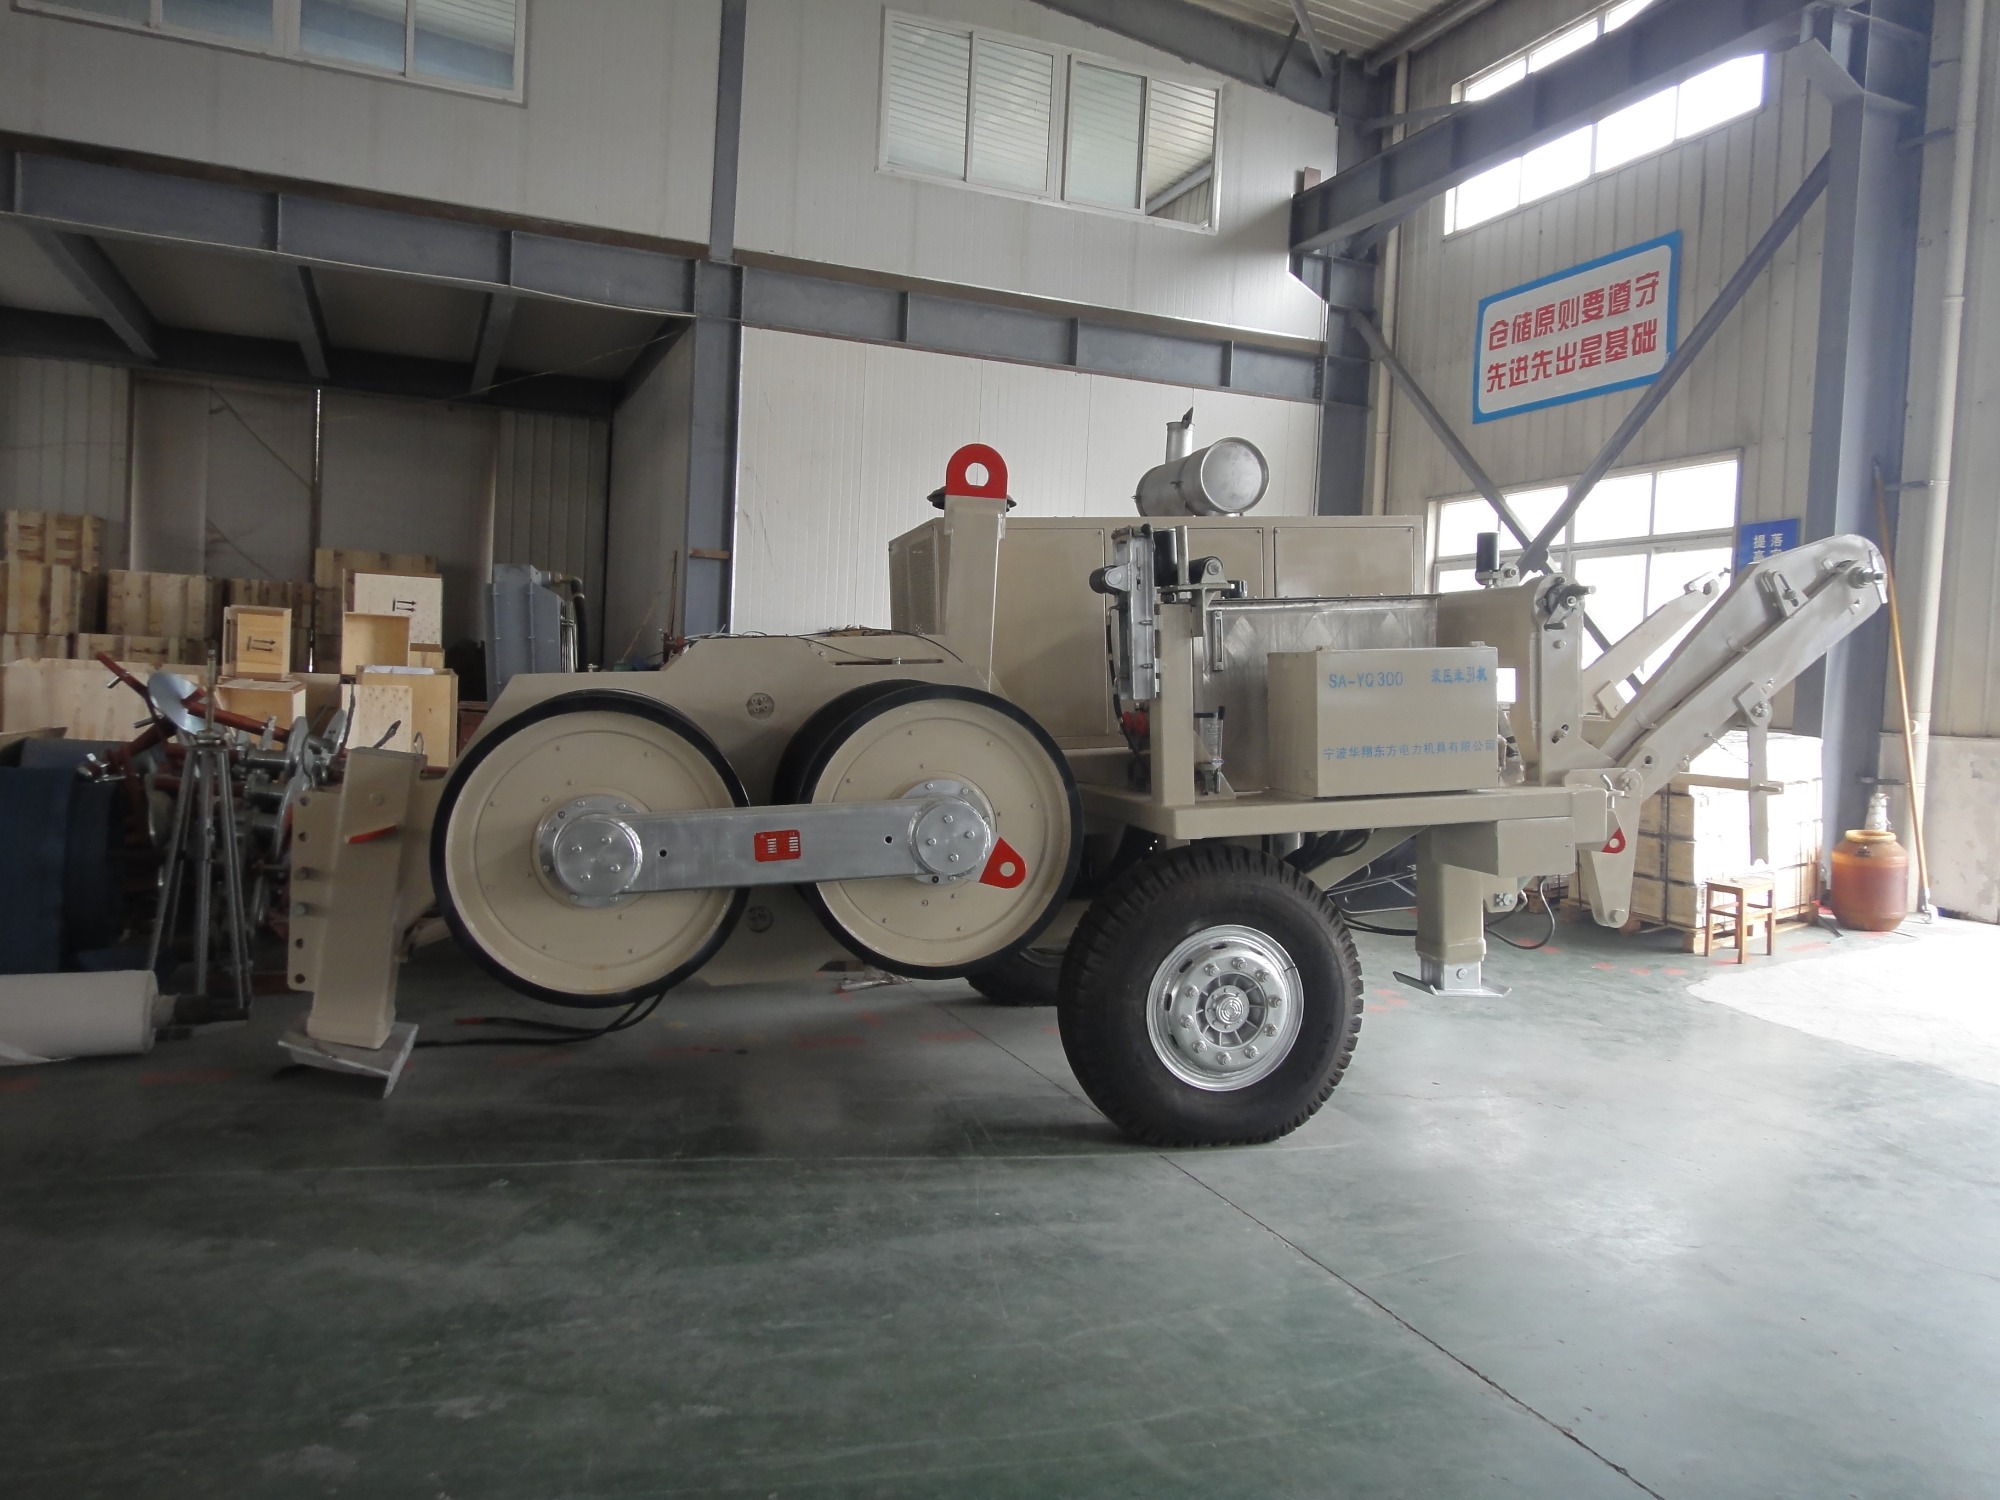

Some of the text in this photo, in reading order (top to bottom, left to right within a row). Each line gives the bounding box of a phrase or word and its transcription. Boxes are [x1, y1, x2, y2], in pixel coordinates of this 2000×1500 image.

[1488, 271, 1660, 351] 仓储原则要遵守
[1486, 318, 1658, 393] 先进先出是基础
[1323, 739, 1495, 760] 宁波华翔东方电力机具有限公司
